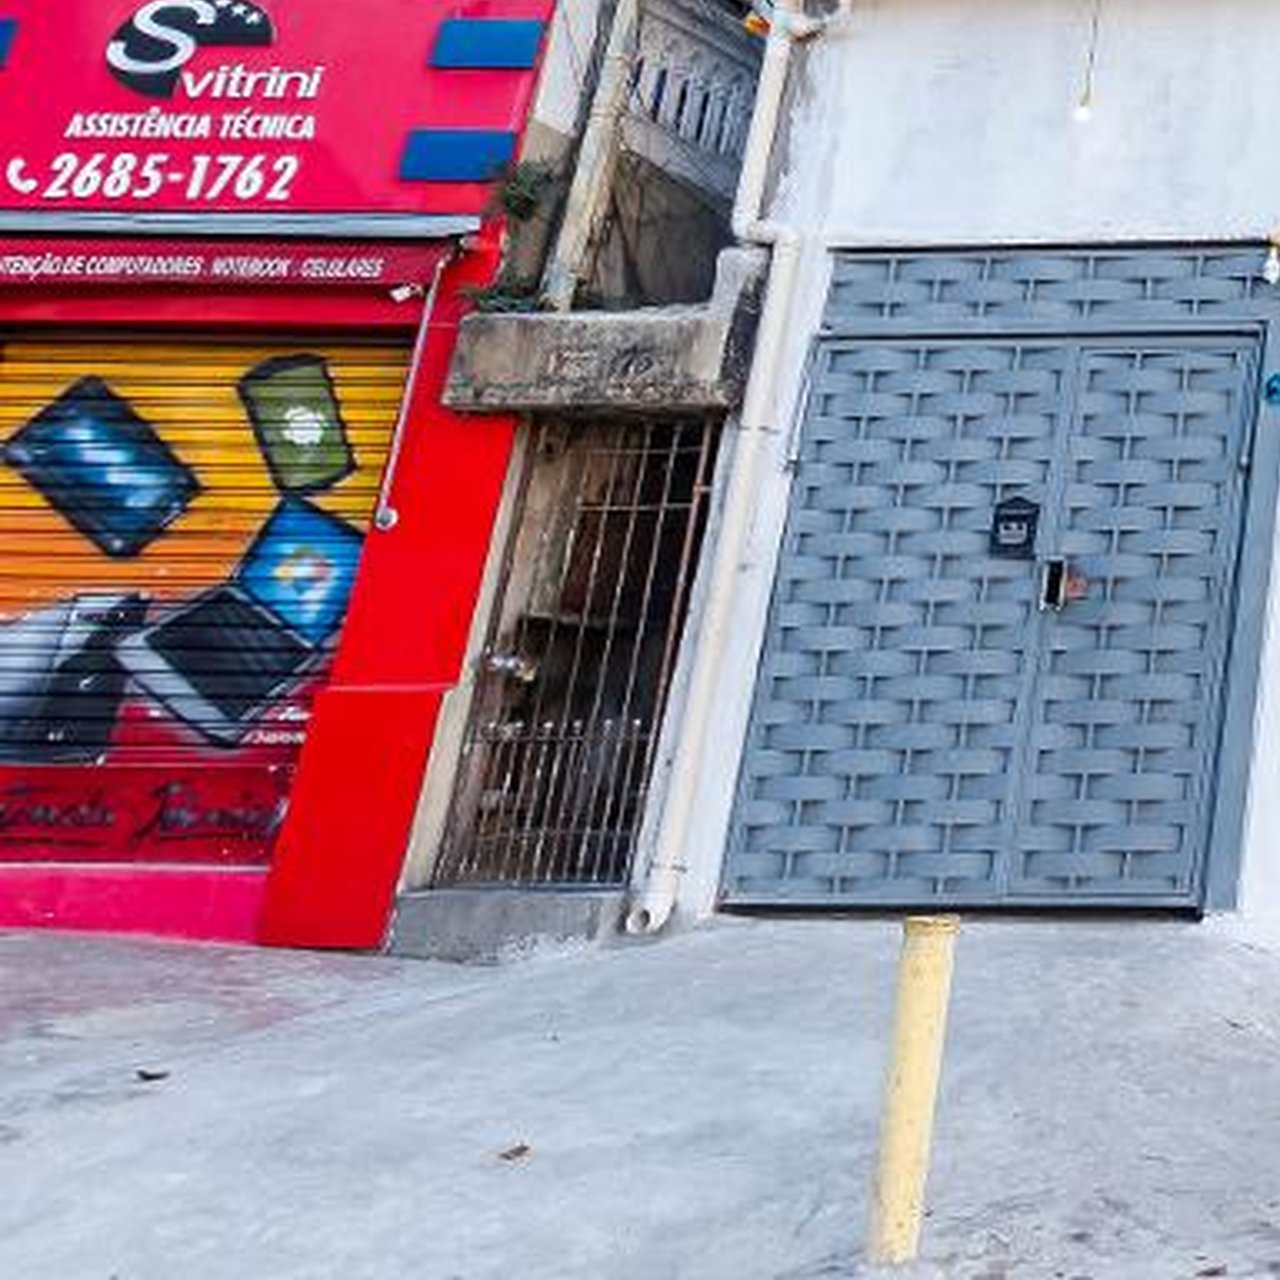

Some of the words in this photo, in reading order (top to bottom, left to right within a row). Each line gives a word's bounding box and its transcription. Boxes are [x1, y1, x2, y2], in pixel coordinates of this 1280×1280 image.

[181, 62, 325, 99] vitrini
[64, 106, 212, 139] ASSISTÊNCIA
[218, 107, 316, 140] TÉCNICA
[42, 152, 299, 200] 2685-1762
